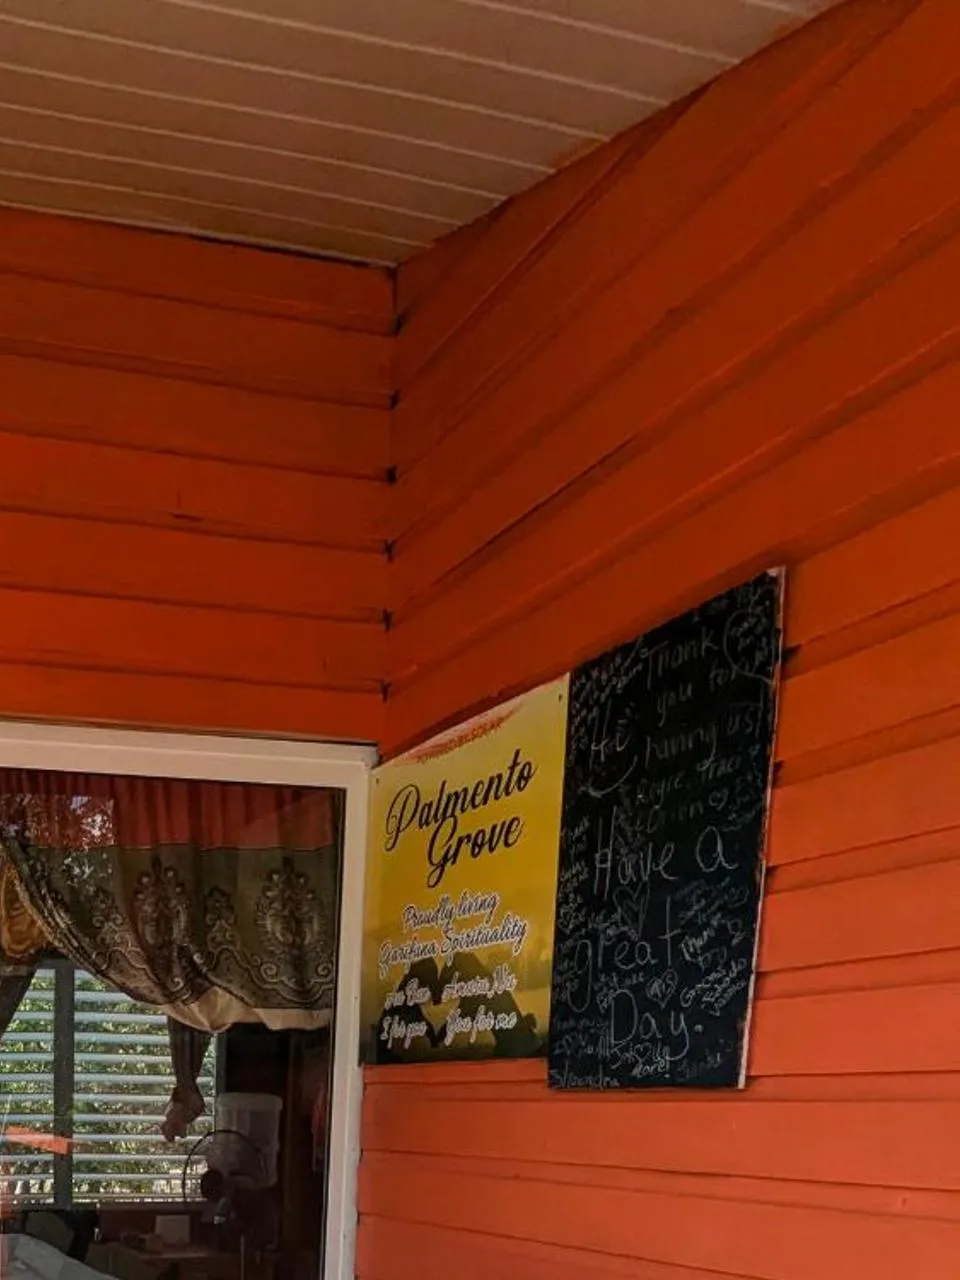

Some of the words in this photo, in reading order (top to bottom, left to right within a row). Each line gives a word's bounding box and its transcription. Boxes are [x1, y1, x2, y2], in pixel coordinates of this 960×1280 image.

[642, 627, 720, 688] Thank
[657, 683, 693, 728] you
[385, 748, 538, 852] Palmento
[428, 815, 525, 888] Grove
[594, 806, 679, 900] Have
[403, 893, 456, 932] Proudly
[455, 890, 500, 926] living
[440, 912, 529, 966] Spirituality
